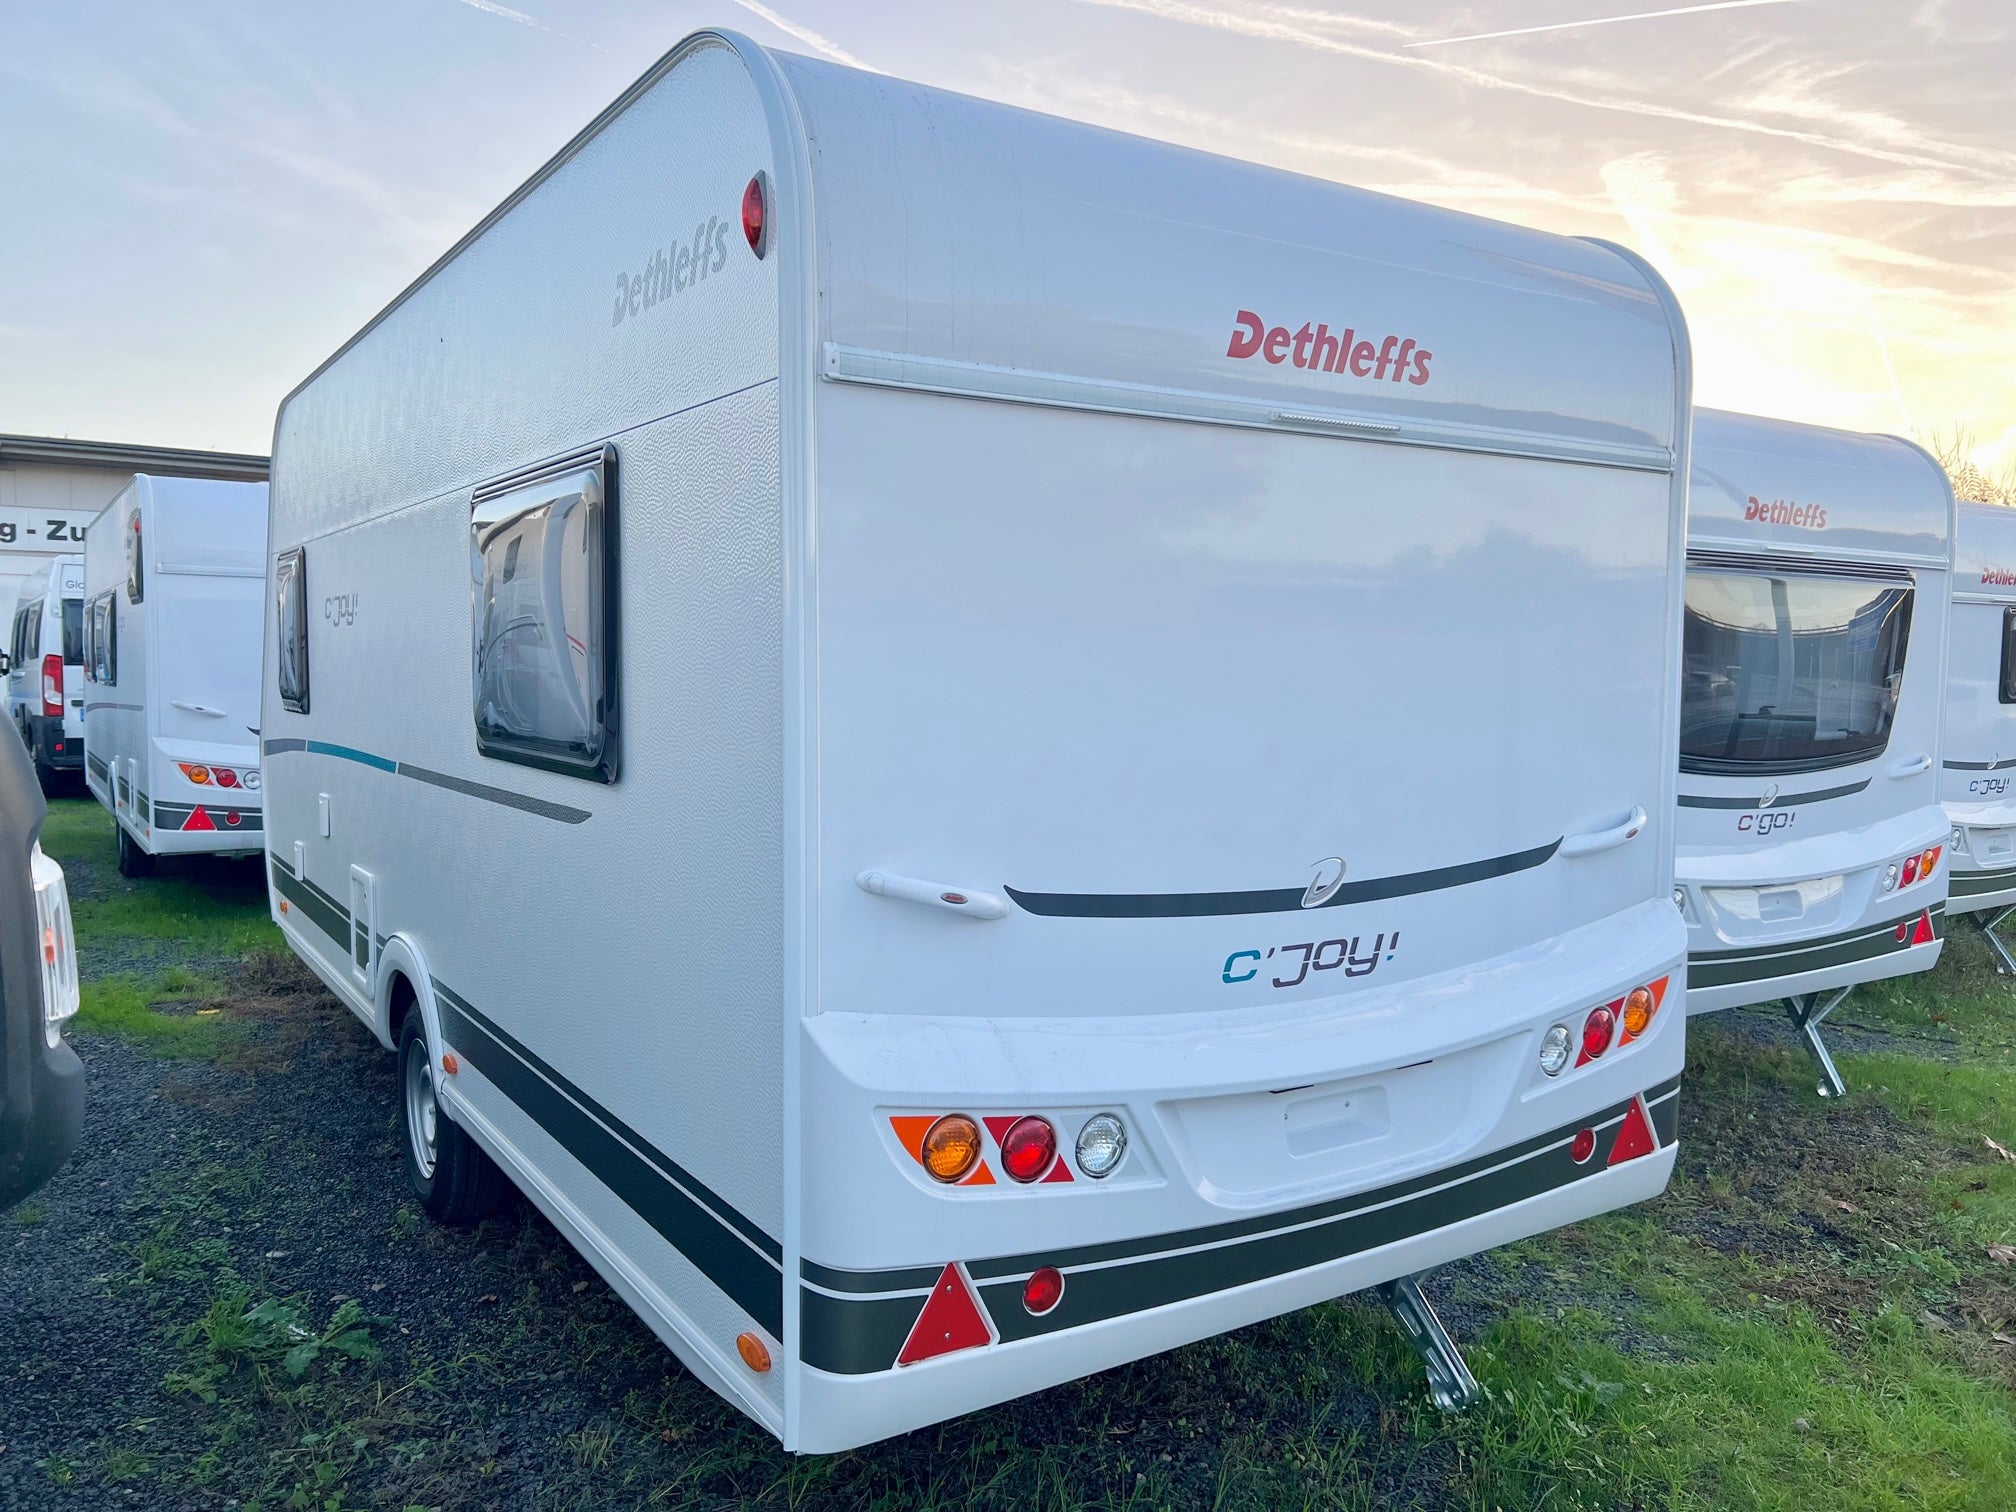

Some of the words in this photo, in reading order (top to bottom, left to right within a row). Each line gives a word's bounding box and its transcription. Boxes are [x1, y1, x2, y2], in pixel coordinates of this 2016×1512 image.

[611, 215, 729, 328] Dethleffs
[1226, 309, 1433, 386] Dethleffs
[1744, 495, 1827, 529] Dethleffs
